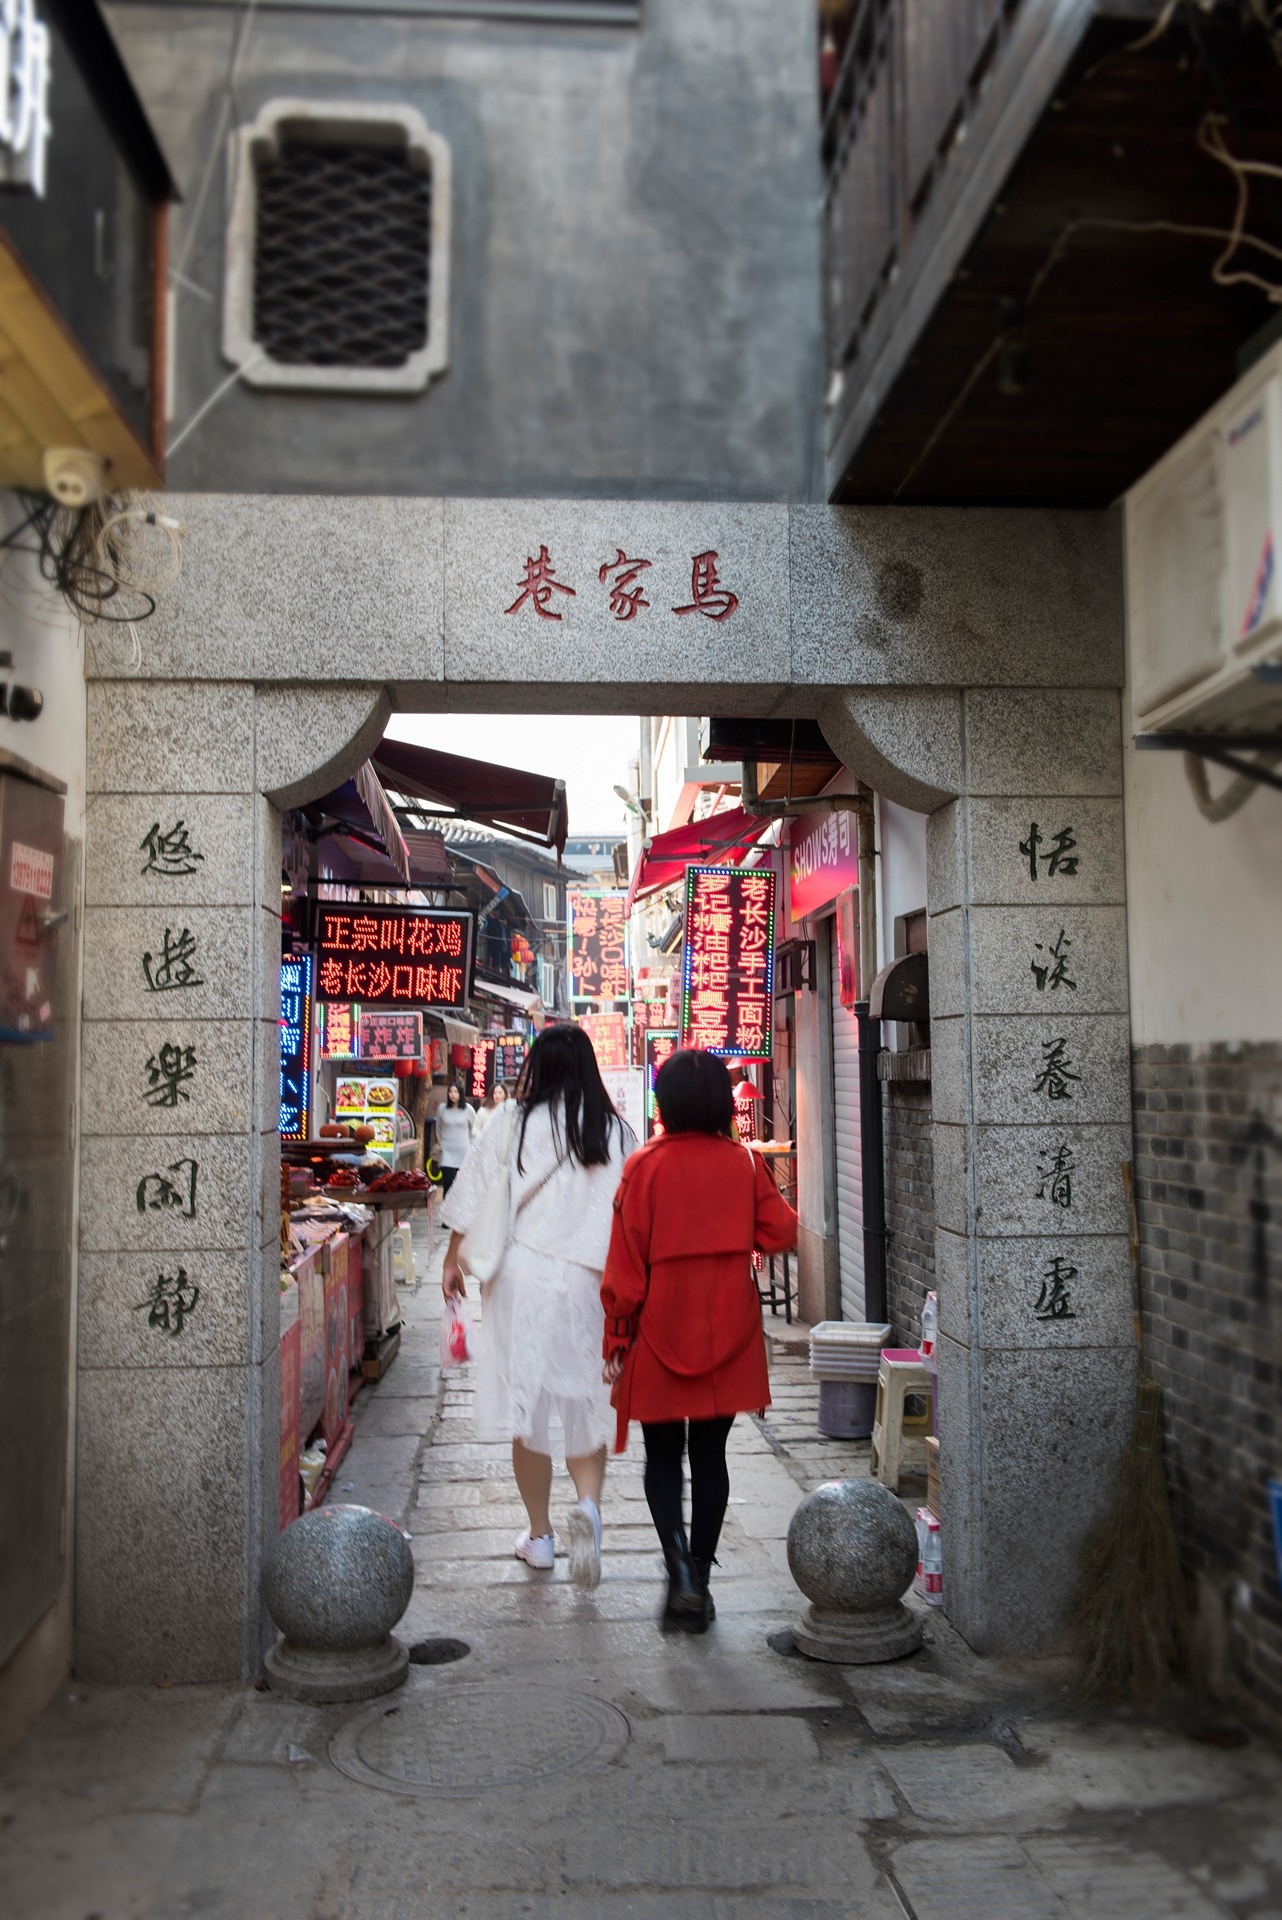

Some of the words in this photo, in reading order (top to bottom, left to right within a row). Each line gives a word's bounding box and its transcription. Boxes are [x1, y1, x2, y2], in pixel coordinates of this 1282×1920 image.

[321, 915, 462, 957] 正宗叫花鸡
[320, 957, 462, 1003] 老长沙口味虾
[735, 877, 769, 1050] 老长沙手工面粉
